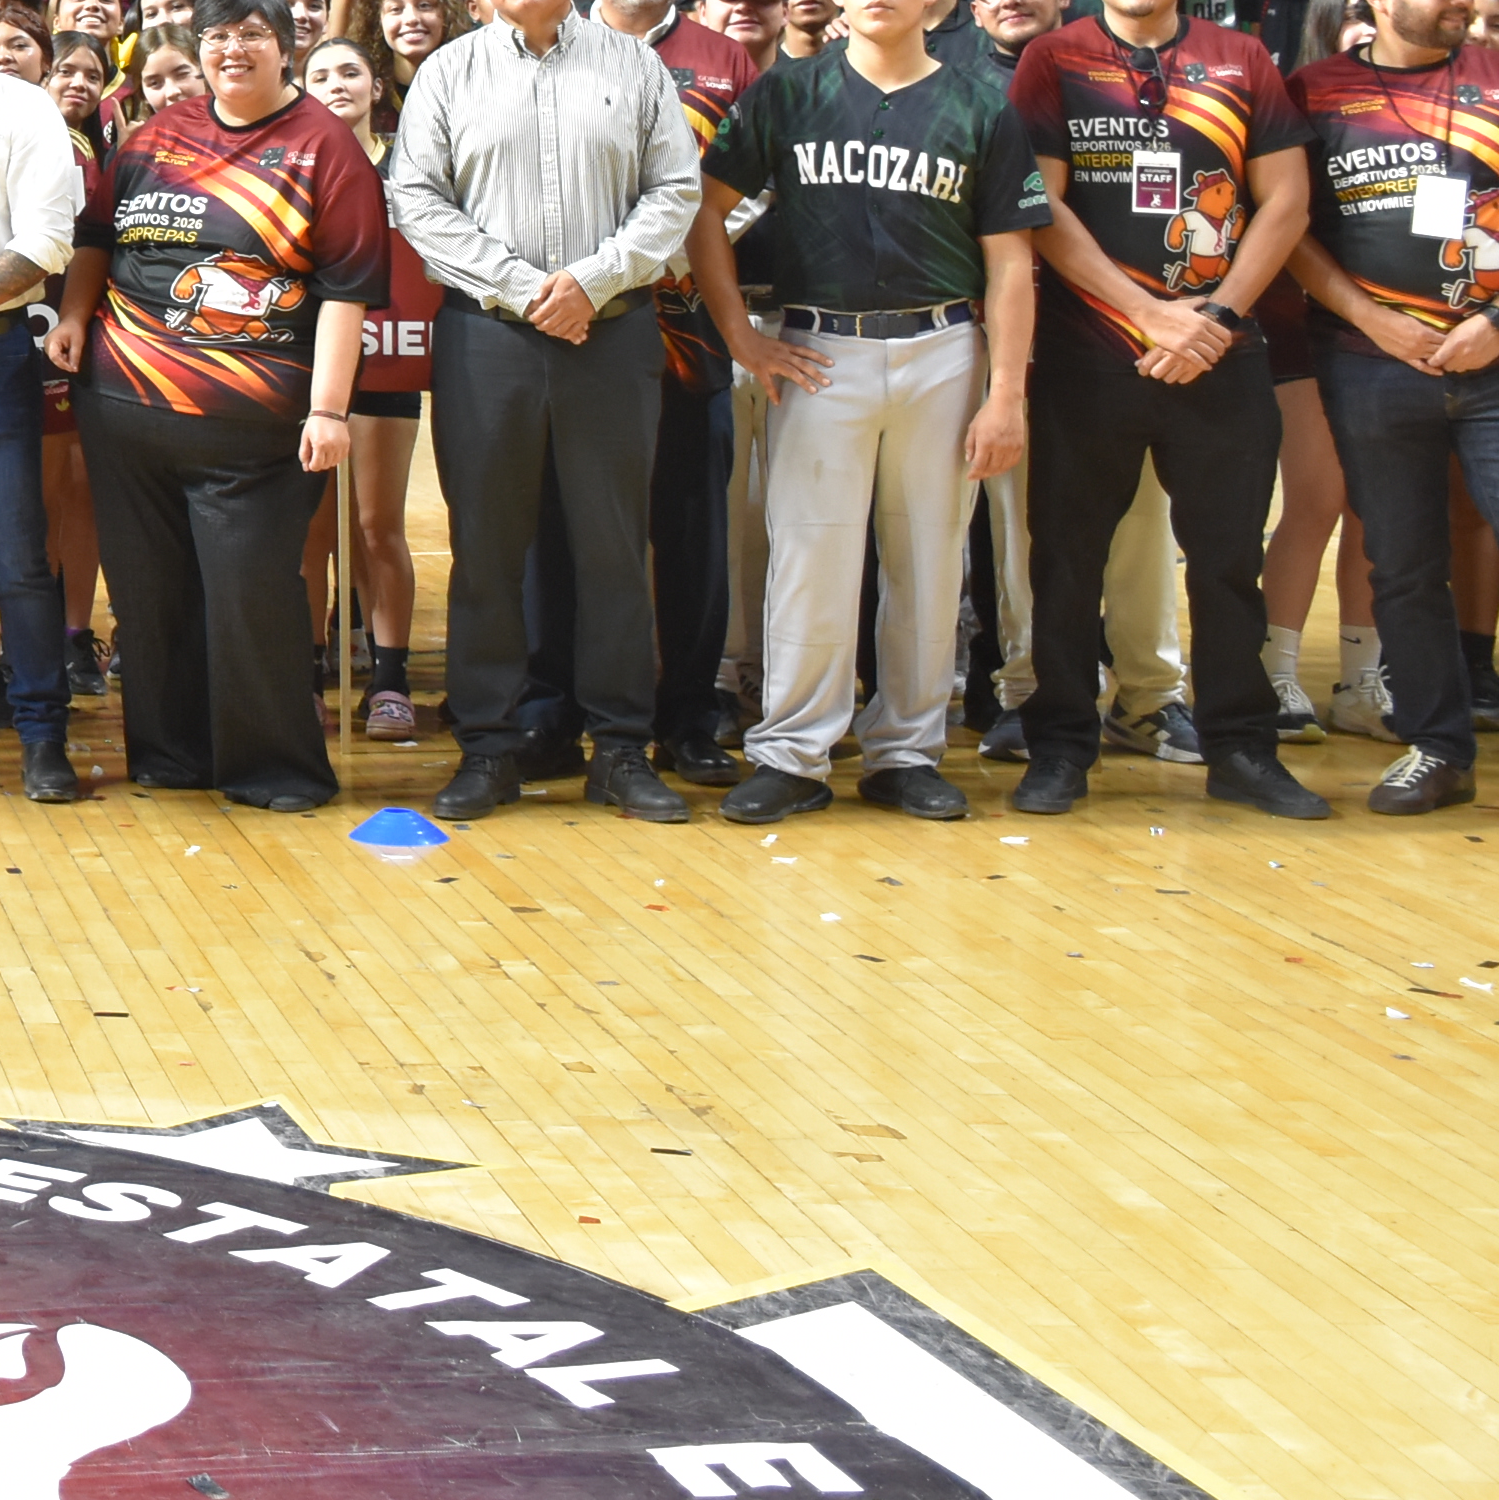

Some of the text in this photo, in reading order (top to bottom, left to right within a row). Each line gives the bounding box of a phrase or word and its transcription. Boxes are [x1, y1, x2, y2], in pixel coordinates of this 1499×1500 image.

[1068, 117, 1170, 138] EVENTOS
[1071, 140, 1142, 152] DEPORTIVOS
[1073, 152, 1132, 168] INTERPR
[1327, 142, 1437, 176] EVENTOS
[793, 140, 970, 204] NACOZARI
[1074, 171, 1132, 183] EN MOVIM
[1140, 174, 1172, 183] STAFF
[1333, 164, 1441, 189] DEPORTIVOS 2026
[1336, 177, 1418, 202] INTERPREP
[1340, 196, 1413, 216] EN MOVIMIE
[173, 217, 203, 230] 2026
